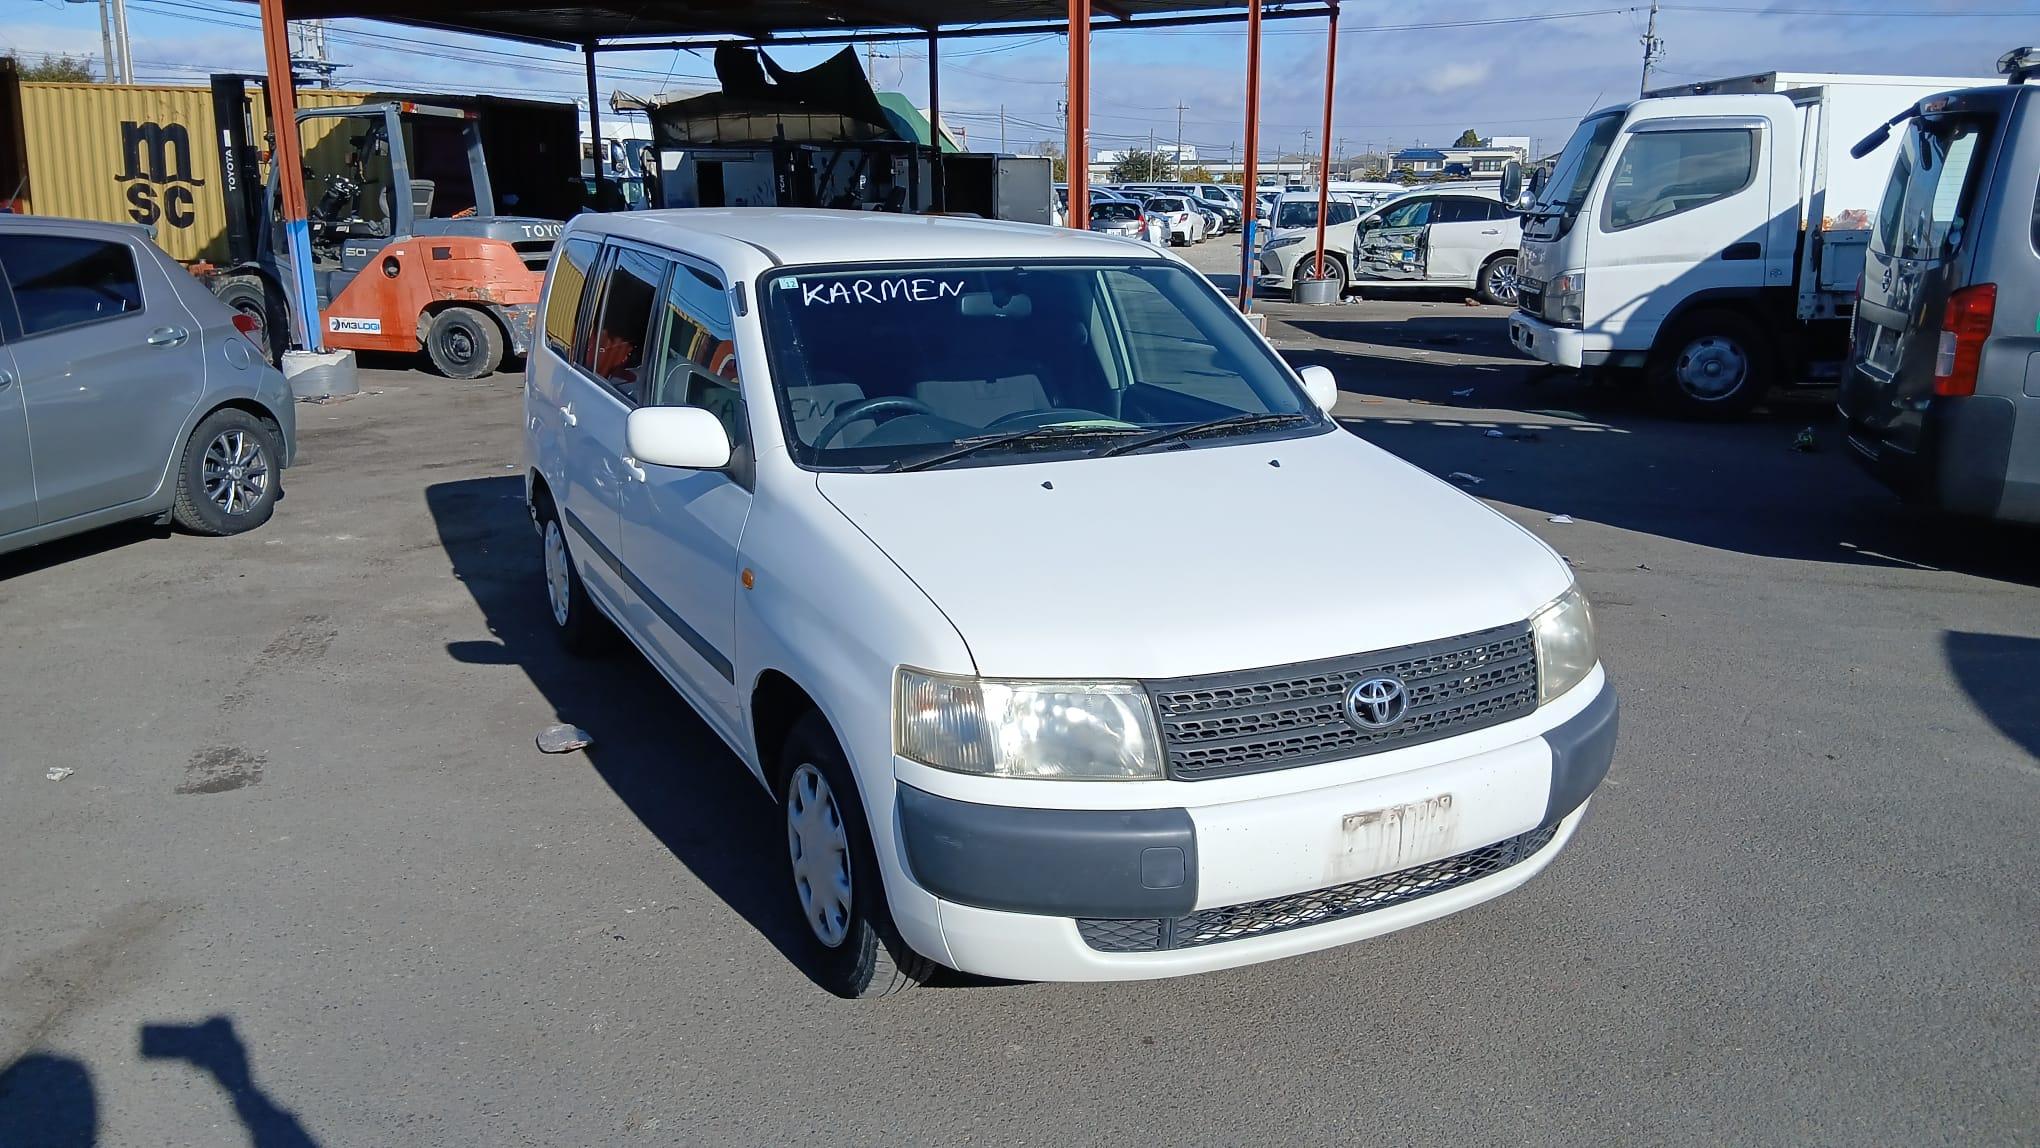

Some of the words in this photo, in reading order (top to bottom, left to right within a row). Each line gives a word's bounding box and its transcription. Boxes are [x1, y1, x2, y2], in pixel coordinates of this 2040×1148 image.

[225, 149, 236, 191] TOYOTA
[345, 247, 367, 257] 50
[802, 279, 965, 306] KARMEN
[341, 321, 380, 331] M3LOGI
